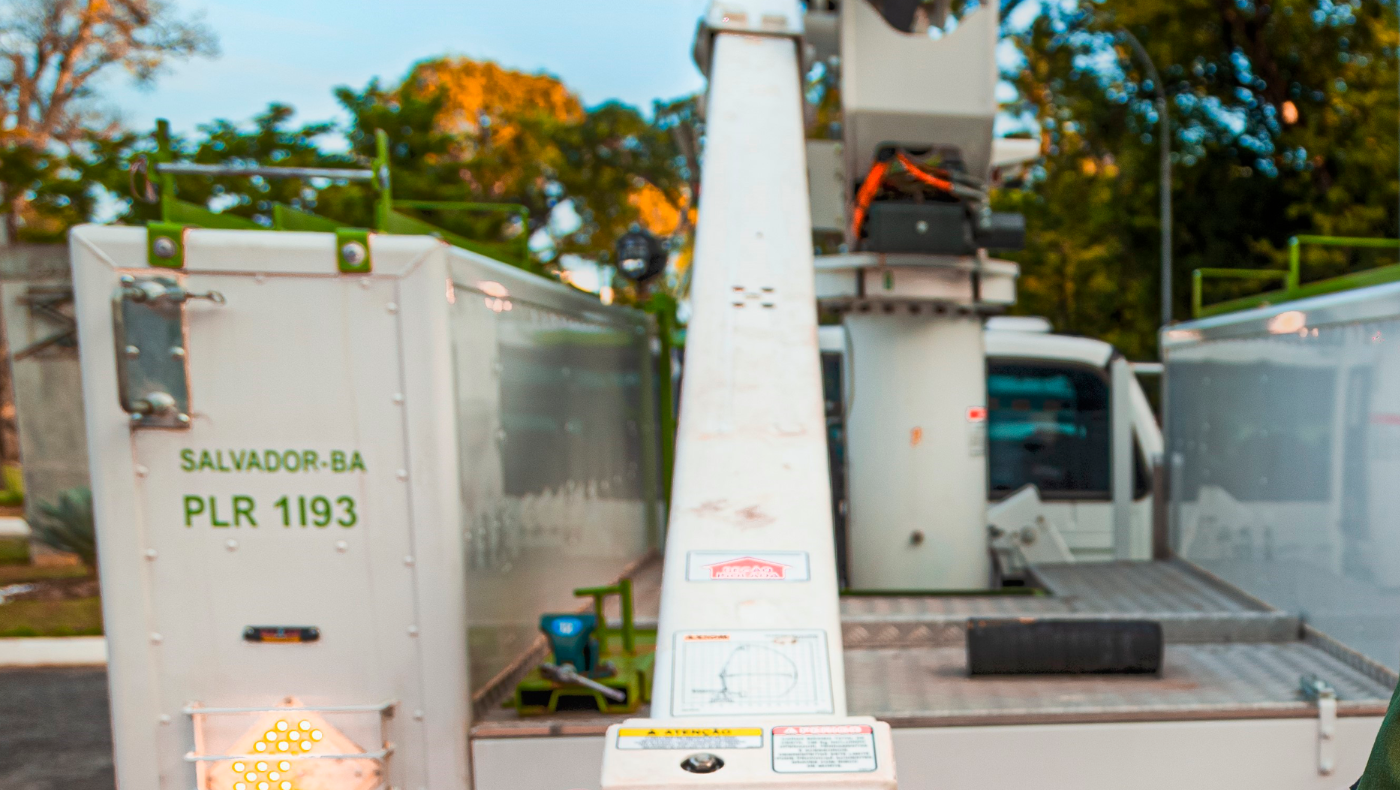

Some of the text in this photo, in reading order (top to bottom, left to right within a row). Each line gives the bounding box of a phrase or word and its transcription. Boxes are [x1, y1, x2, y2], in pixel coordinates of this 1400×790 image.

[179, 448, 367, 473] SALVADOR-BA
[183, 495, 258, 528] PLR
[665, 727, 733, 736] ATENÇÃO
